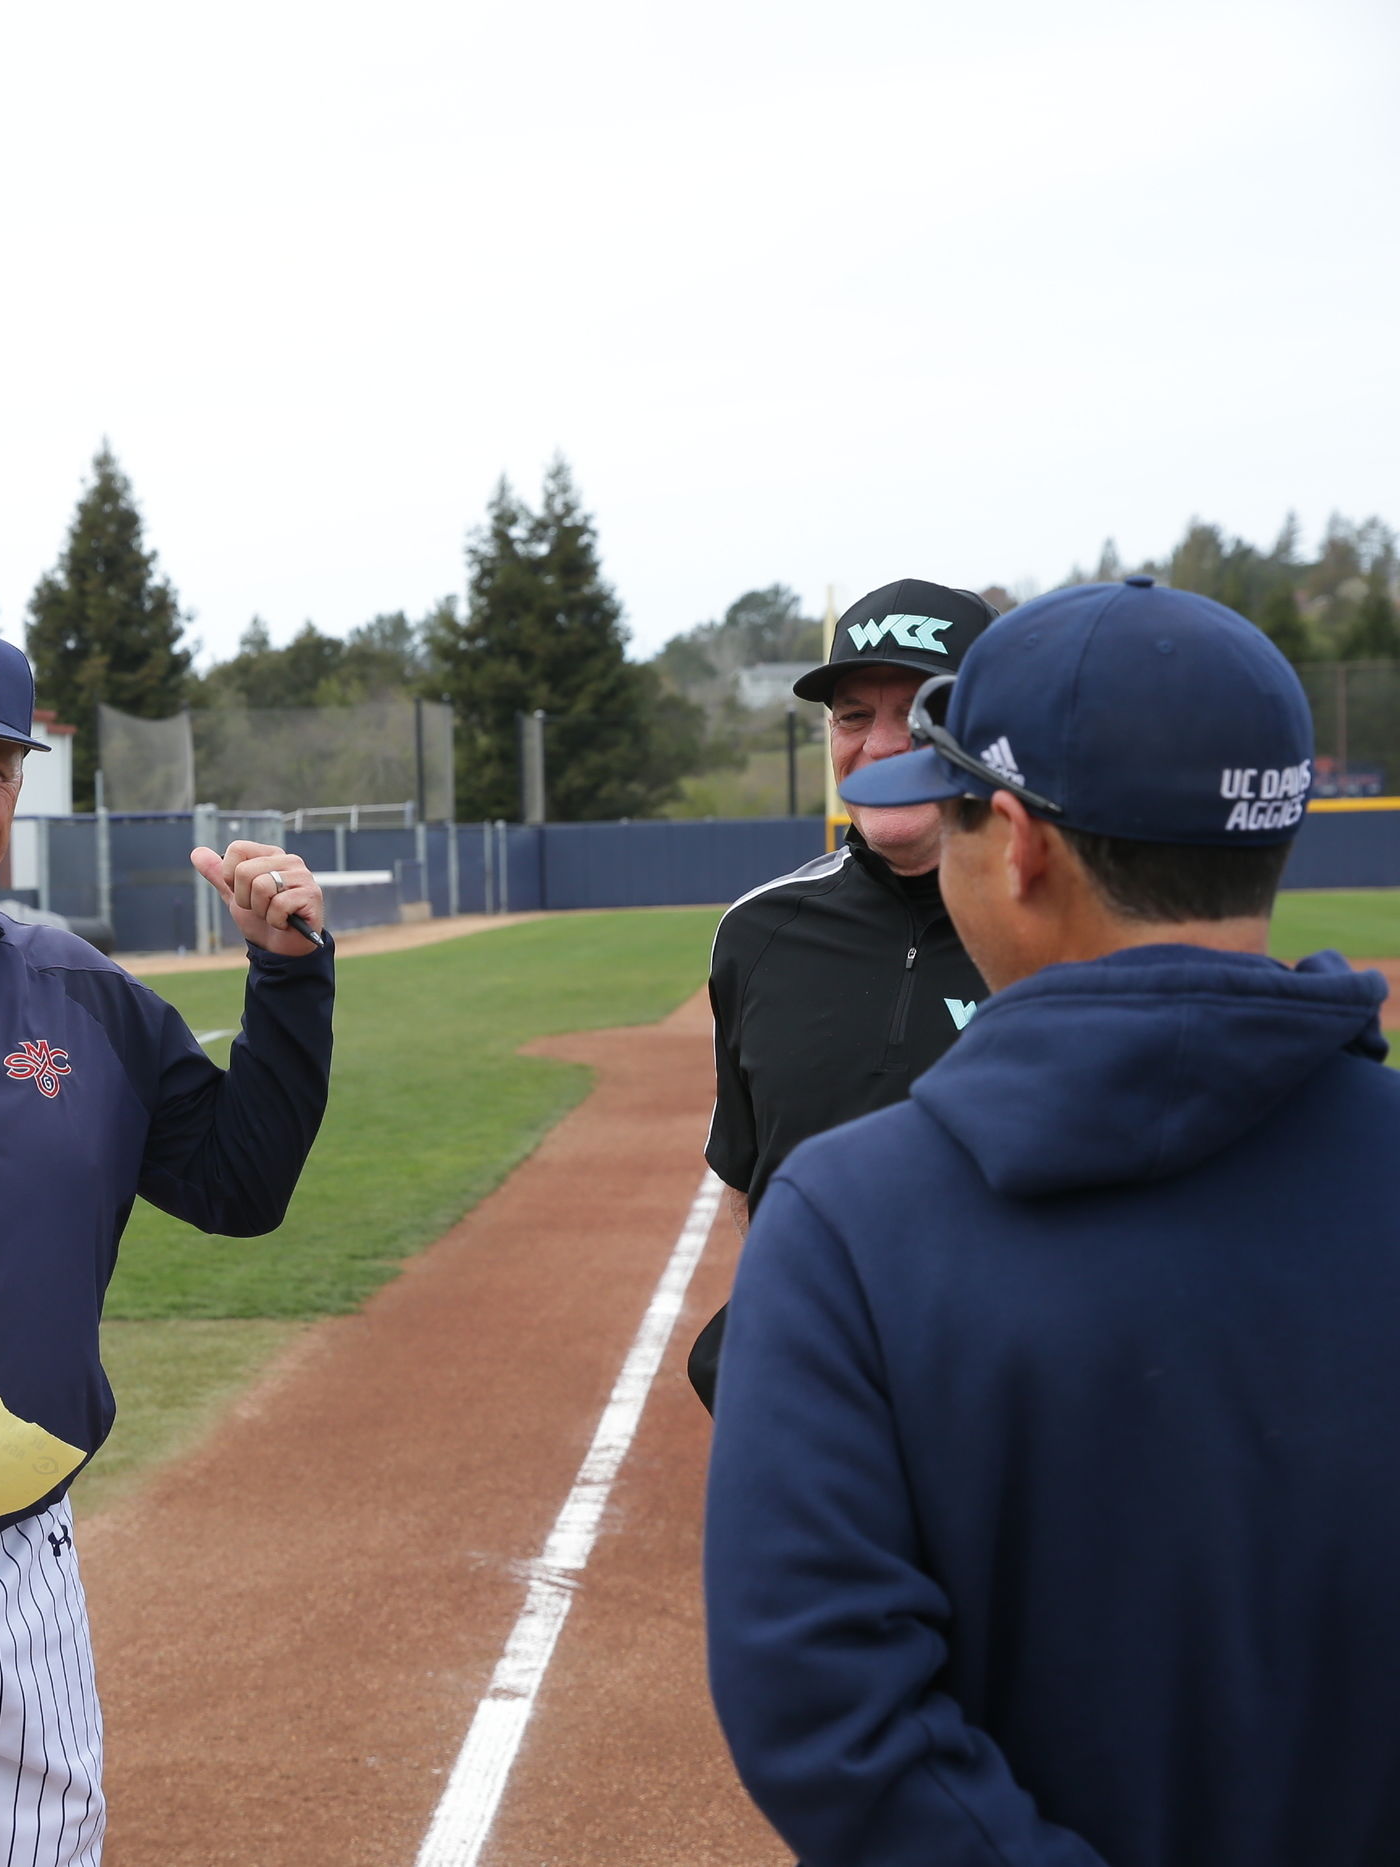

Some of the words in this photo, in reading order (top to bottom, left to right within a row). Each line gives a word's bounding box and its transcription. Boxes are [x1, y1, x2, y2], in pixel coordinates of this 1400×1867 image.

[847, 613, 954, 655] WCC
[1220, 768, 1257, 799] UC
[1225, 793, 1303, 831] AGGIES
[3, 1039, 72, 1081] SMC
